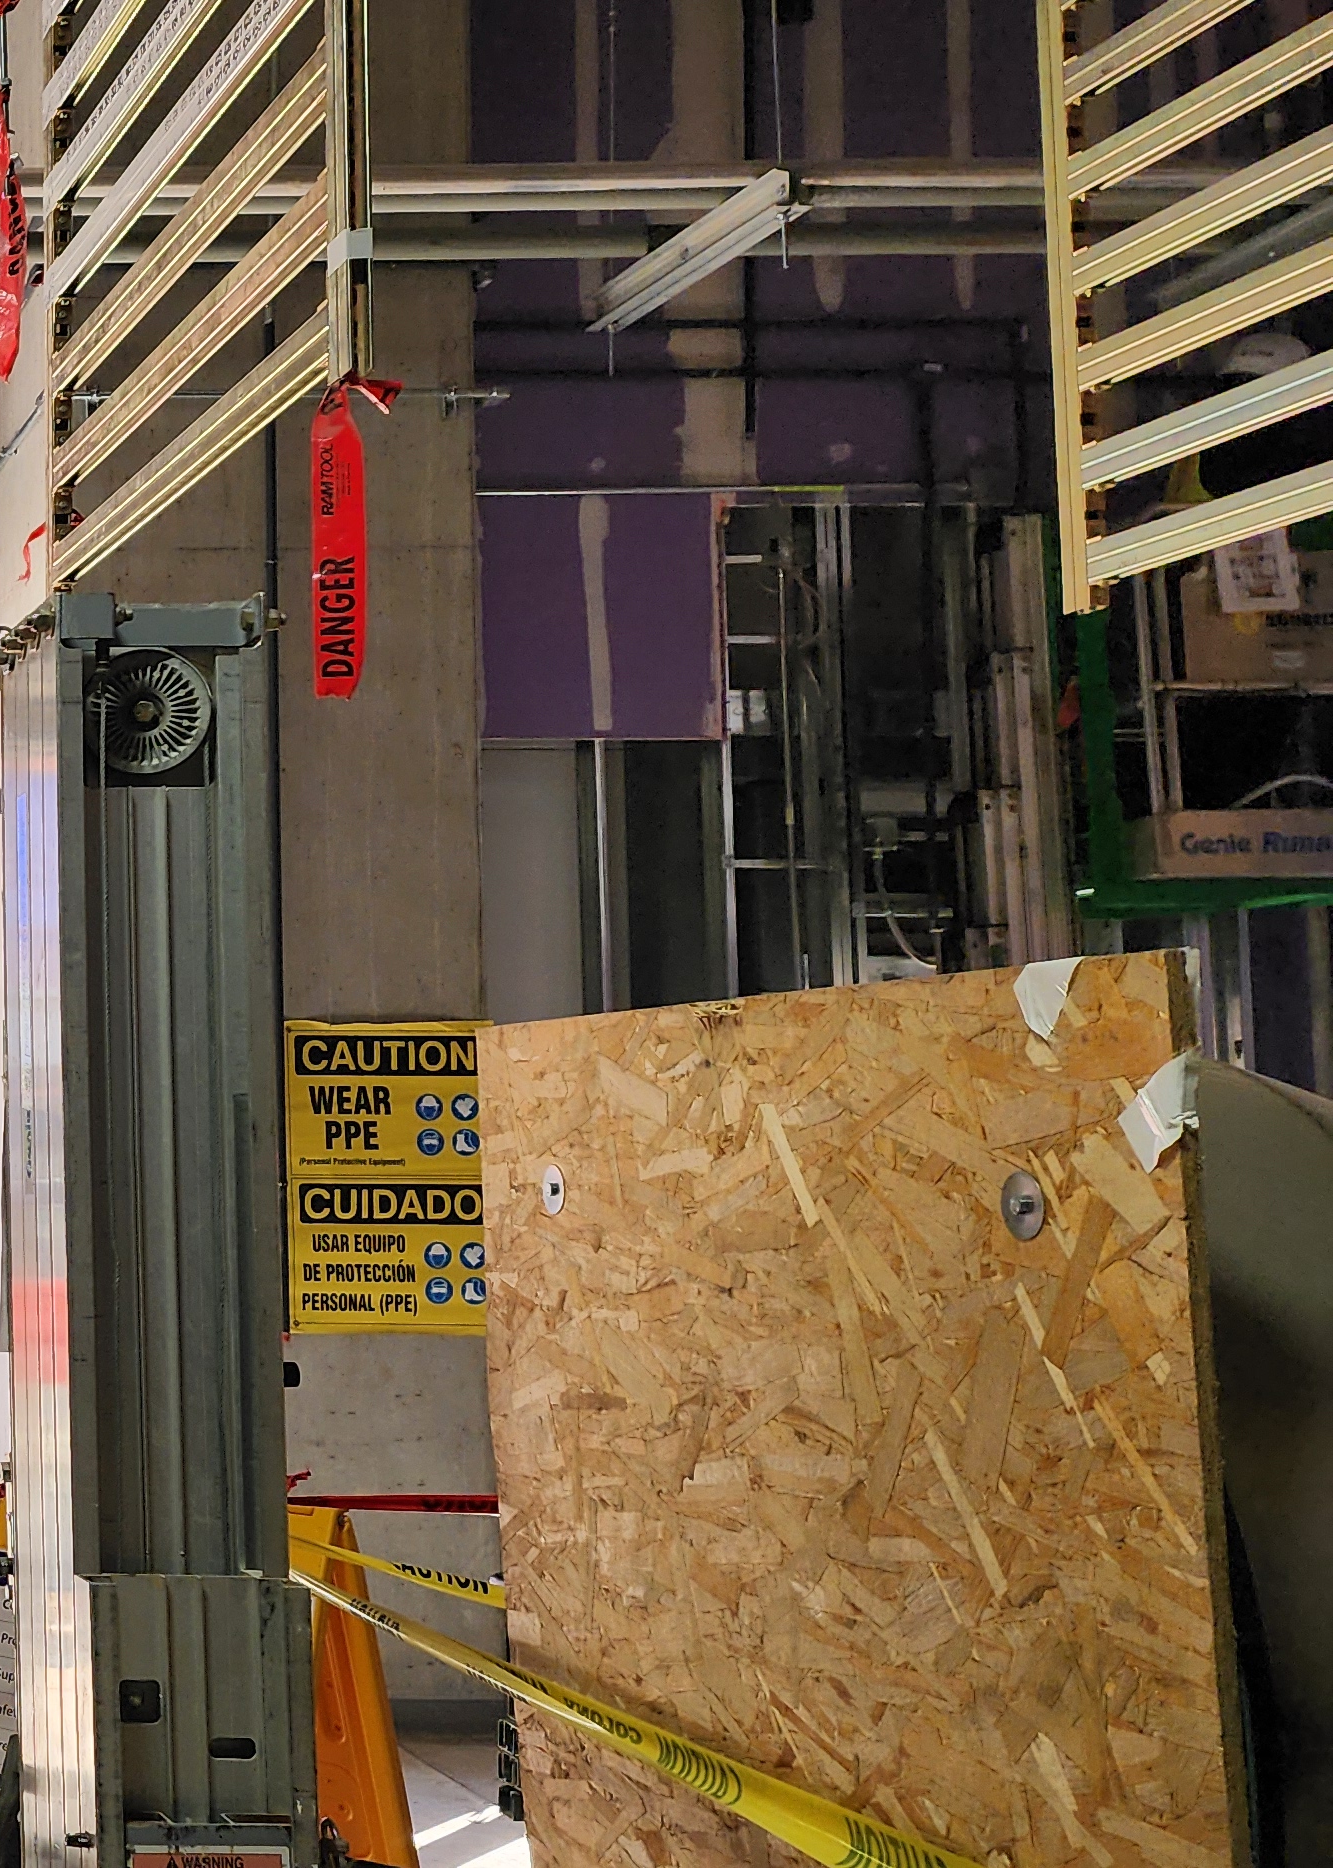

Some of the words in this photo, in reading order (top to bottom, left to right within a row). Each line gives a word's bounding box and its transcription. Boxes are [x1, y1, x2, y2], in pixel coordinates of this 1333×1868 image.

[320, 556, 355, 679] DANGER
[301, 1040, 475, 1072] CAUTION
[308, 1085, 393, 1116] WEAR
[325, 1120, 380, 1151] PPE
[299, 1157, 332, 1167] (Personal
[333, 1157, 367, 1167] Protective
[368, 1157, 406, 1168] Equipment)
[303, 1188, 482, 1221] CUIDADO
[311, 1233, 350, 1254] USAR
[354, 1233, 406, 1254] EQUIPO
[302, 1262, 322, 1283] DE
[326, 1258, 417, 1284] PROTECCIÓN
[301, 1293, 375, 1313] PERSONAL
[379, 1294, 419, 1317] (PPE)
[393, 1562, 489, 1595] AUTION
